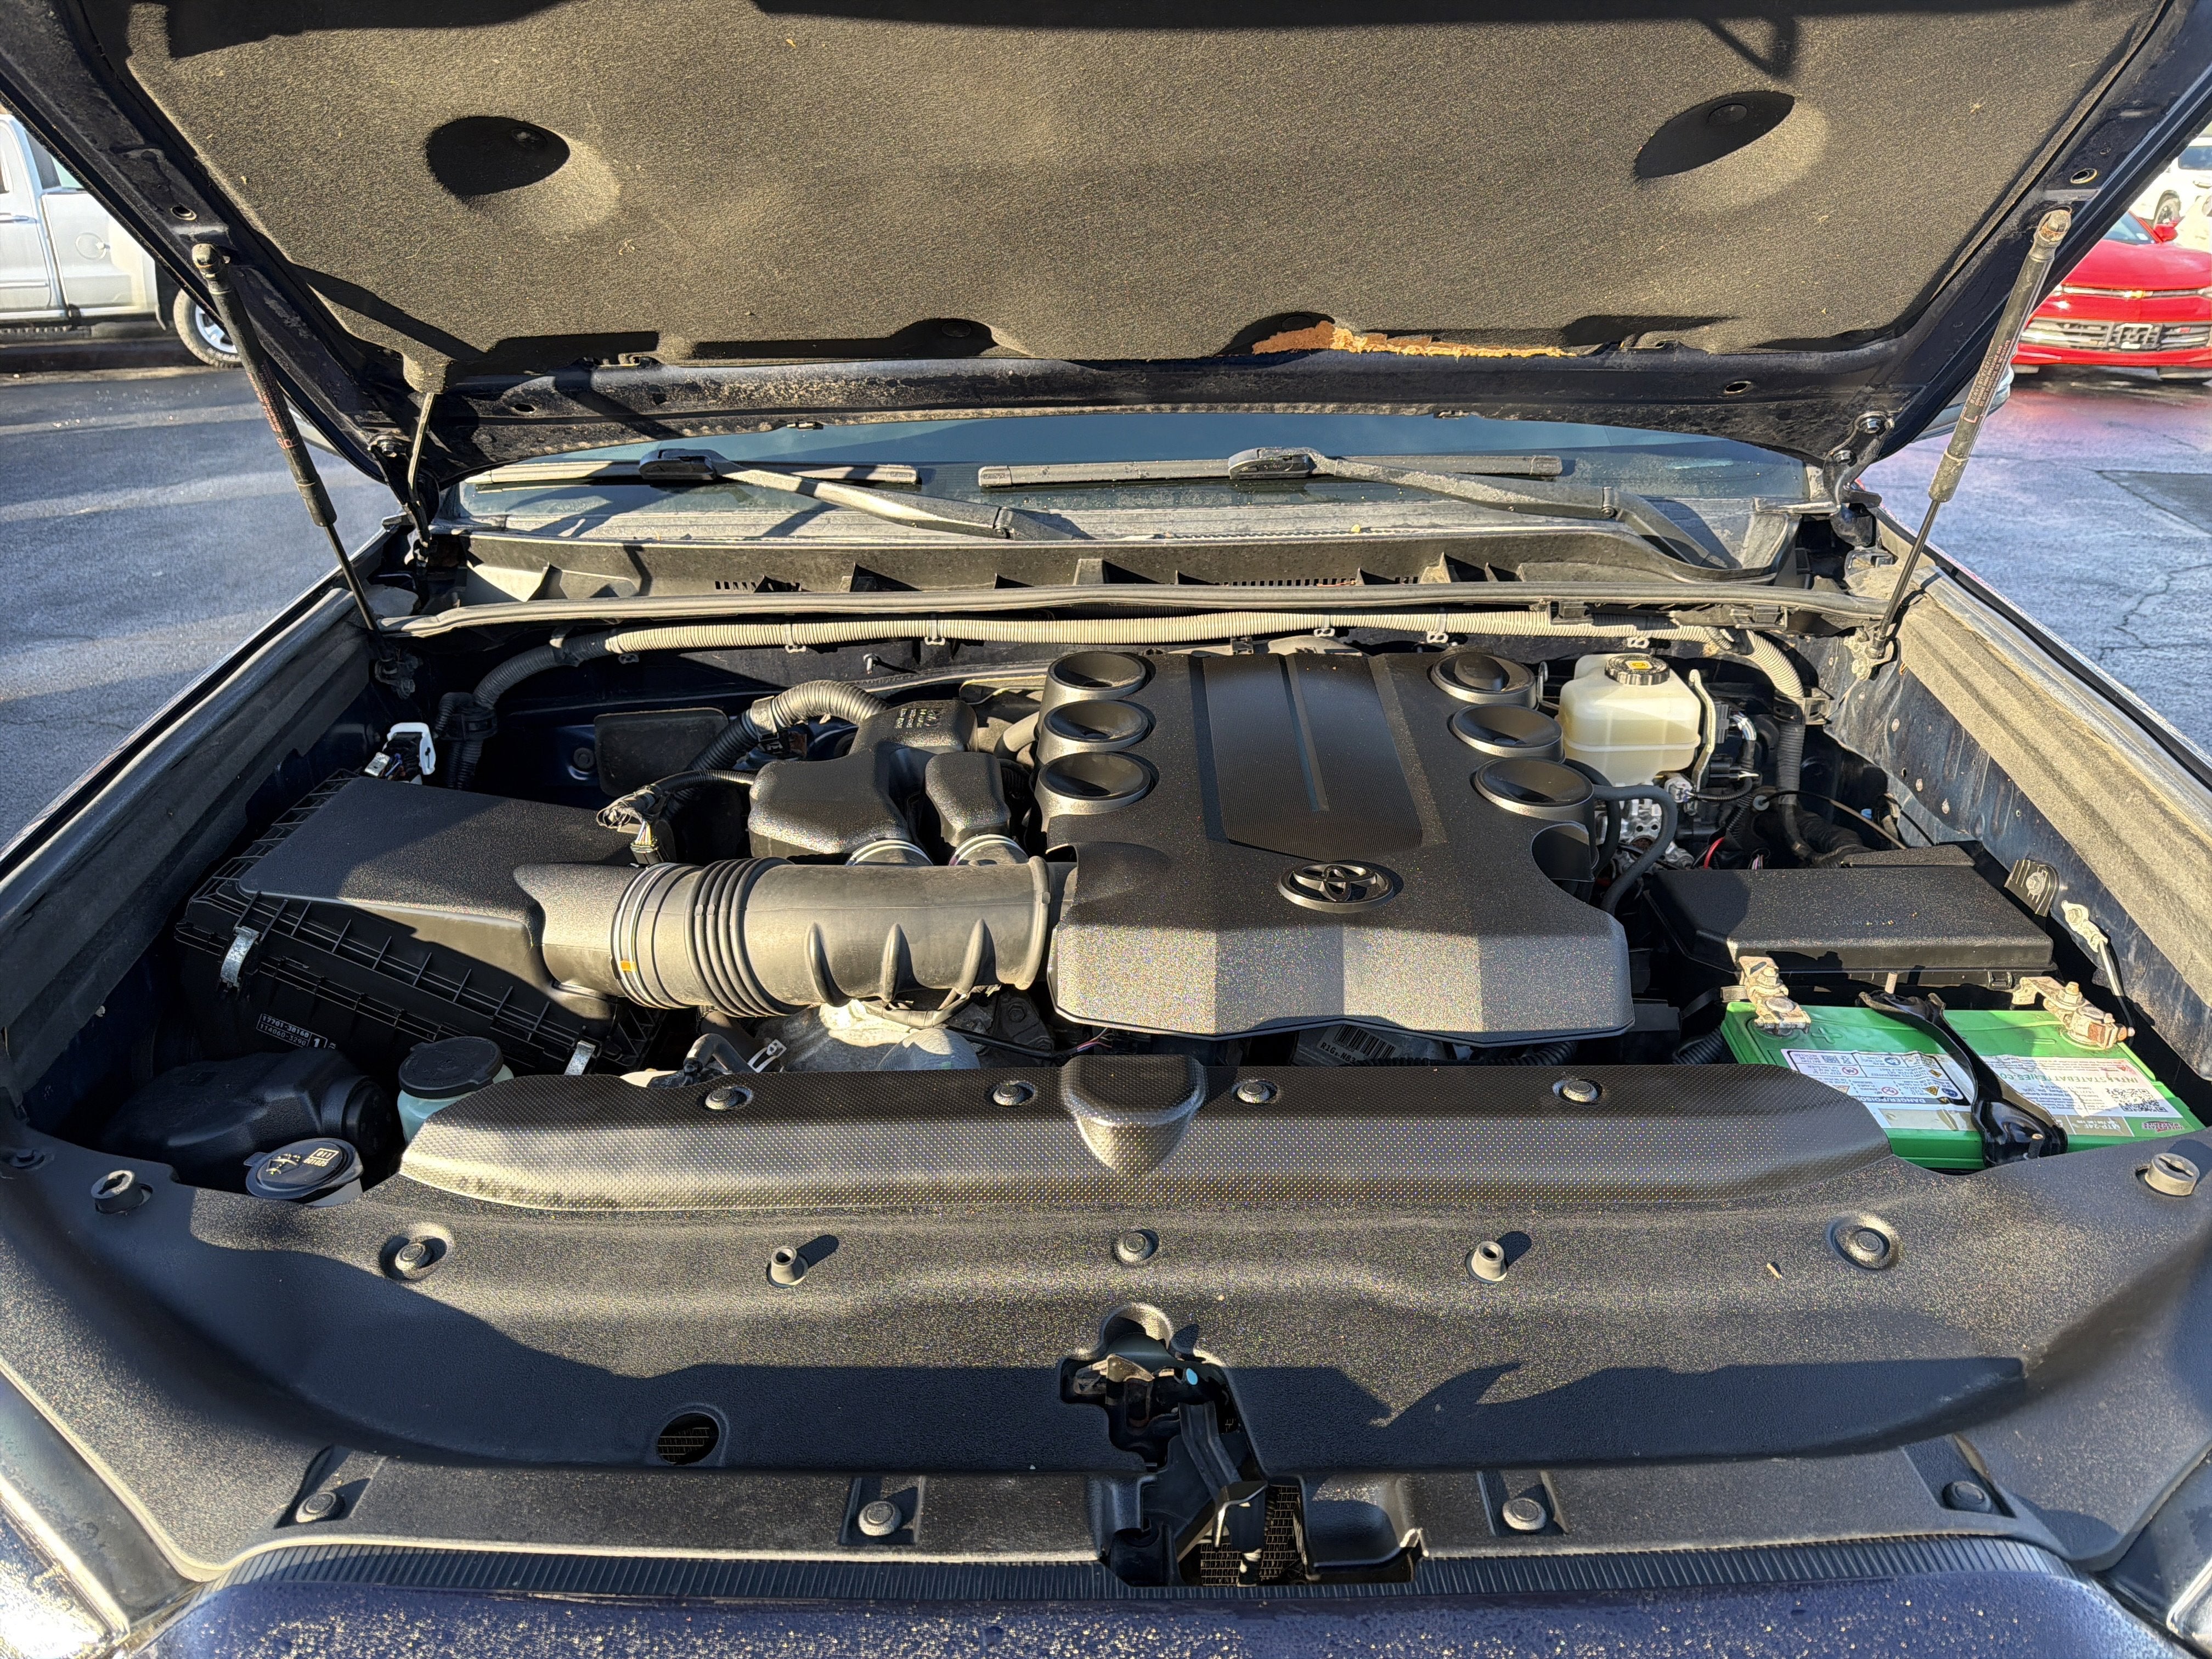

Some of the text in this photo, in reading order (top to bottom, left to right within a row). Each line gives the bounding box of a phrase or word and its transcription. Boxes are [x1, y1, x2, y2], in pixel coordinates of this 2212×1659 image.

[1985, 370, 1998, 392] PUNCTURE
[1997, 339, 2011, 363] INCINERATE
[1987, 355, 1999, 376] PRESSURE
[313, 1038, 320, 1048] 1
[2000, 1074, 2138, 1082] INTERSTATEBATTERIES.CO
